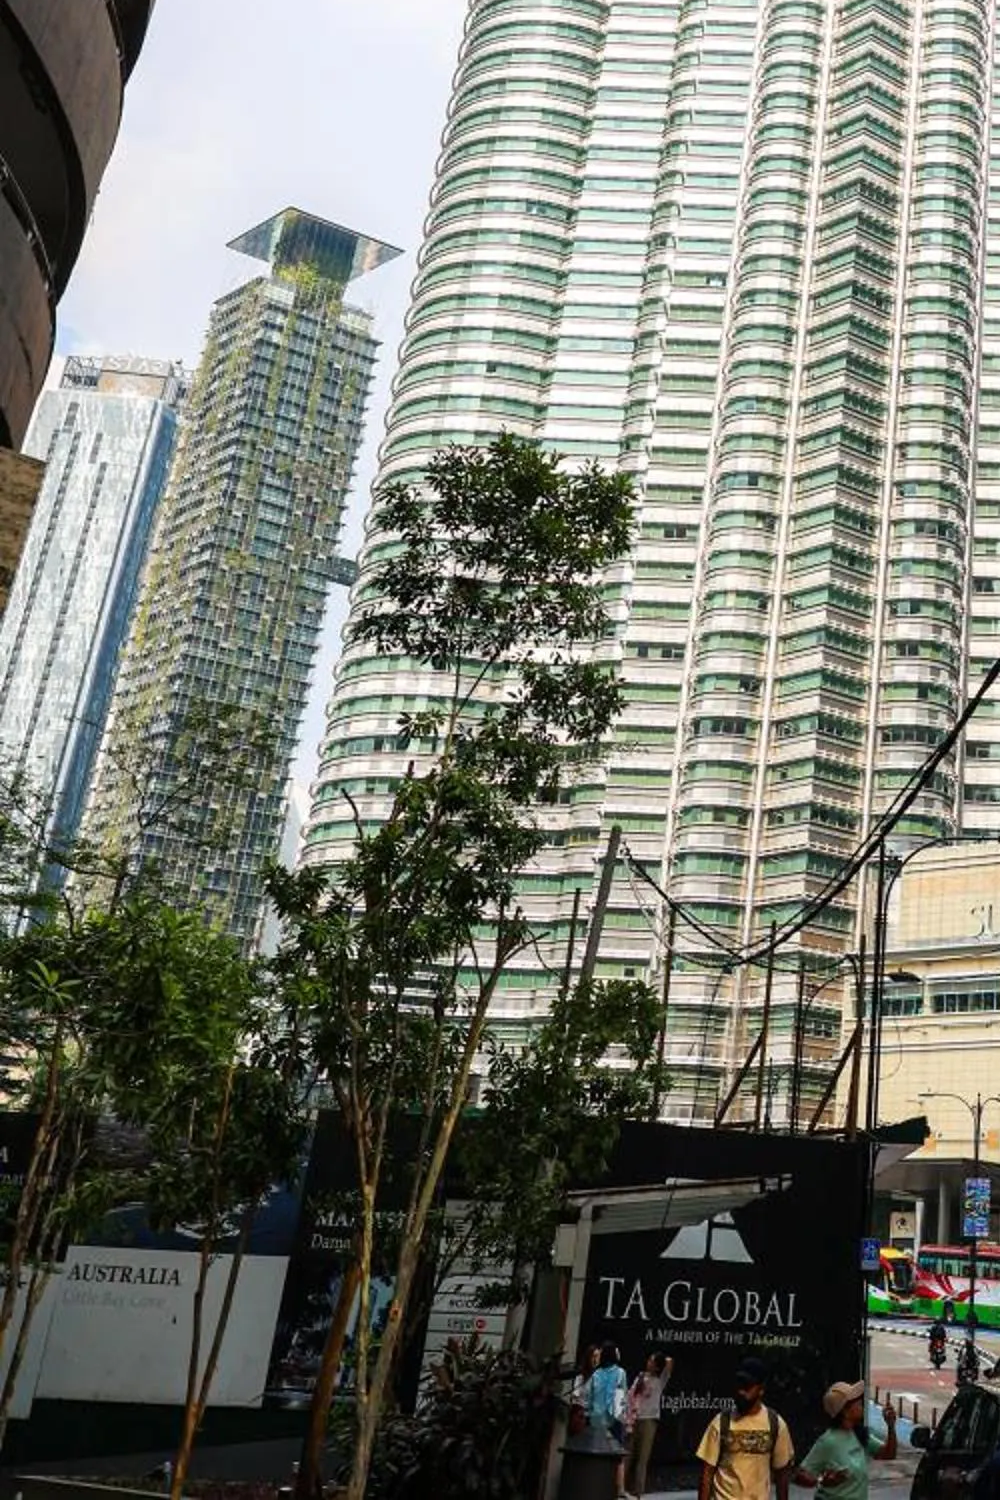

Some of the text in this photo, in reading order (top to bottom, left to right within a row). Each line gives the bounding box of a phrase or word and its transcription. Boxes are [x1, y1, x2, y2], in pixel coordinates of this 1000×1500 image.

[67, 1263, 182, 1286] AUSTRALIA
[599, 1276, 804, 1328] TA GLOBAL
[645, 1328, 654, 1341] A
[656, 1329, 704, 1344] MEMBER
[705, 1331, 721, 1344] OF
[723, 1331, 745, 1346] THE
